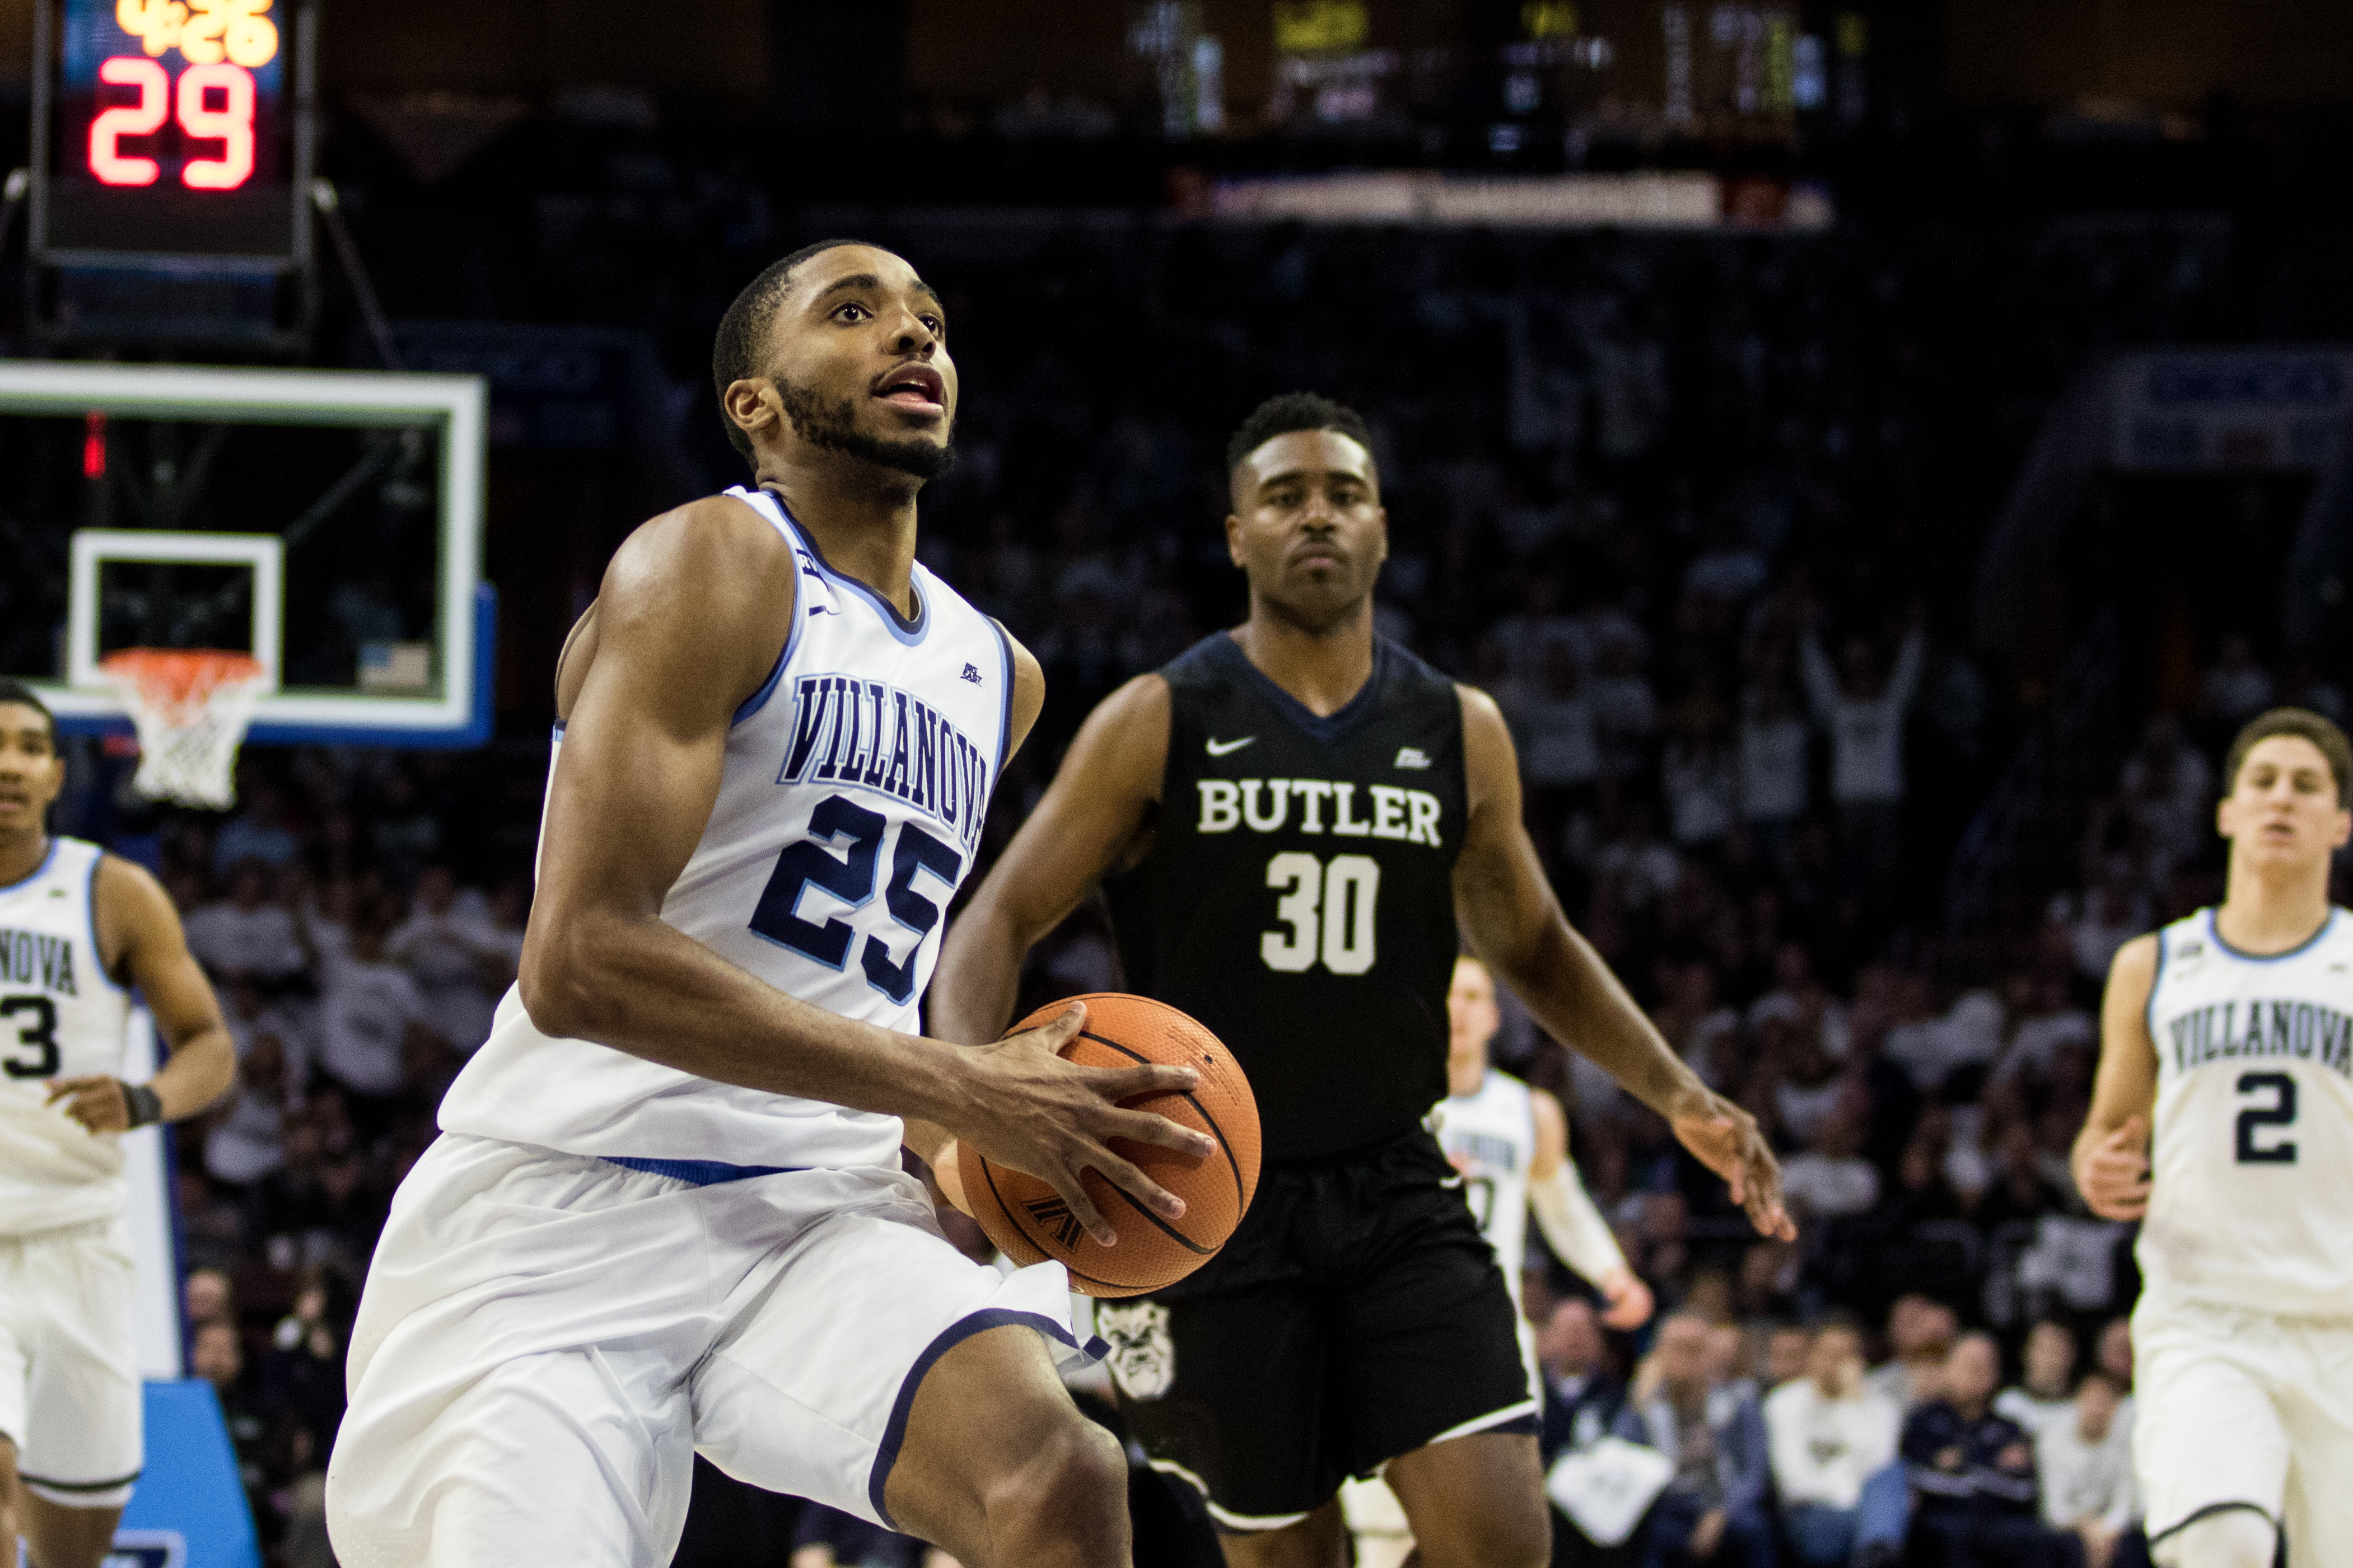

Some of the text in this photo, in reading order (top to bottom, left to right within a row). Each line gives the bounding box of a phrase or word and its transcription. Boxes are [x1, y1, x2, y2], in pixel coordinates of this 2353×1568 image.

[88, 56, 255, 189] 29
[777, 674, 987, 862] VILLANOVA
[1197, 778, 1442, 848] BUTLER
[748, 794, 963, 1007] 25
[1260, 850, 1380, 975] 30
[0, 994, 59, 1079] 3
[2169, 999, 2353, 1080] VILLANOVA
[2235, 1071, 2297, 1164] 2
